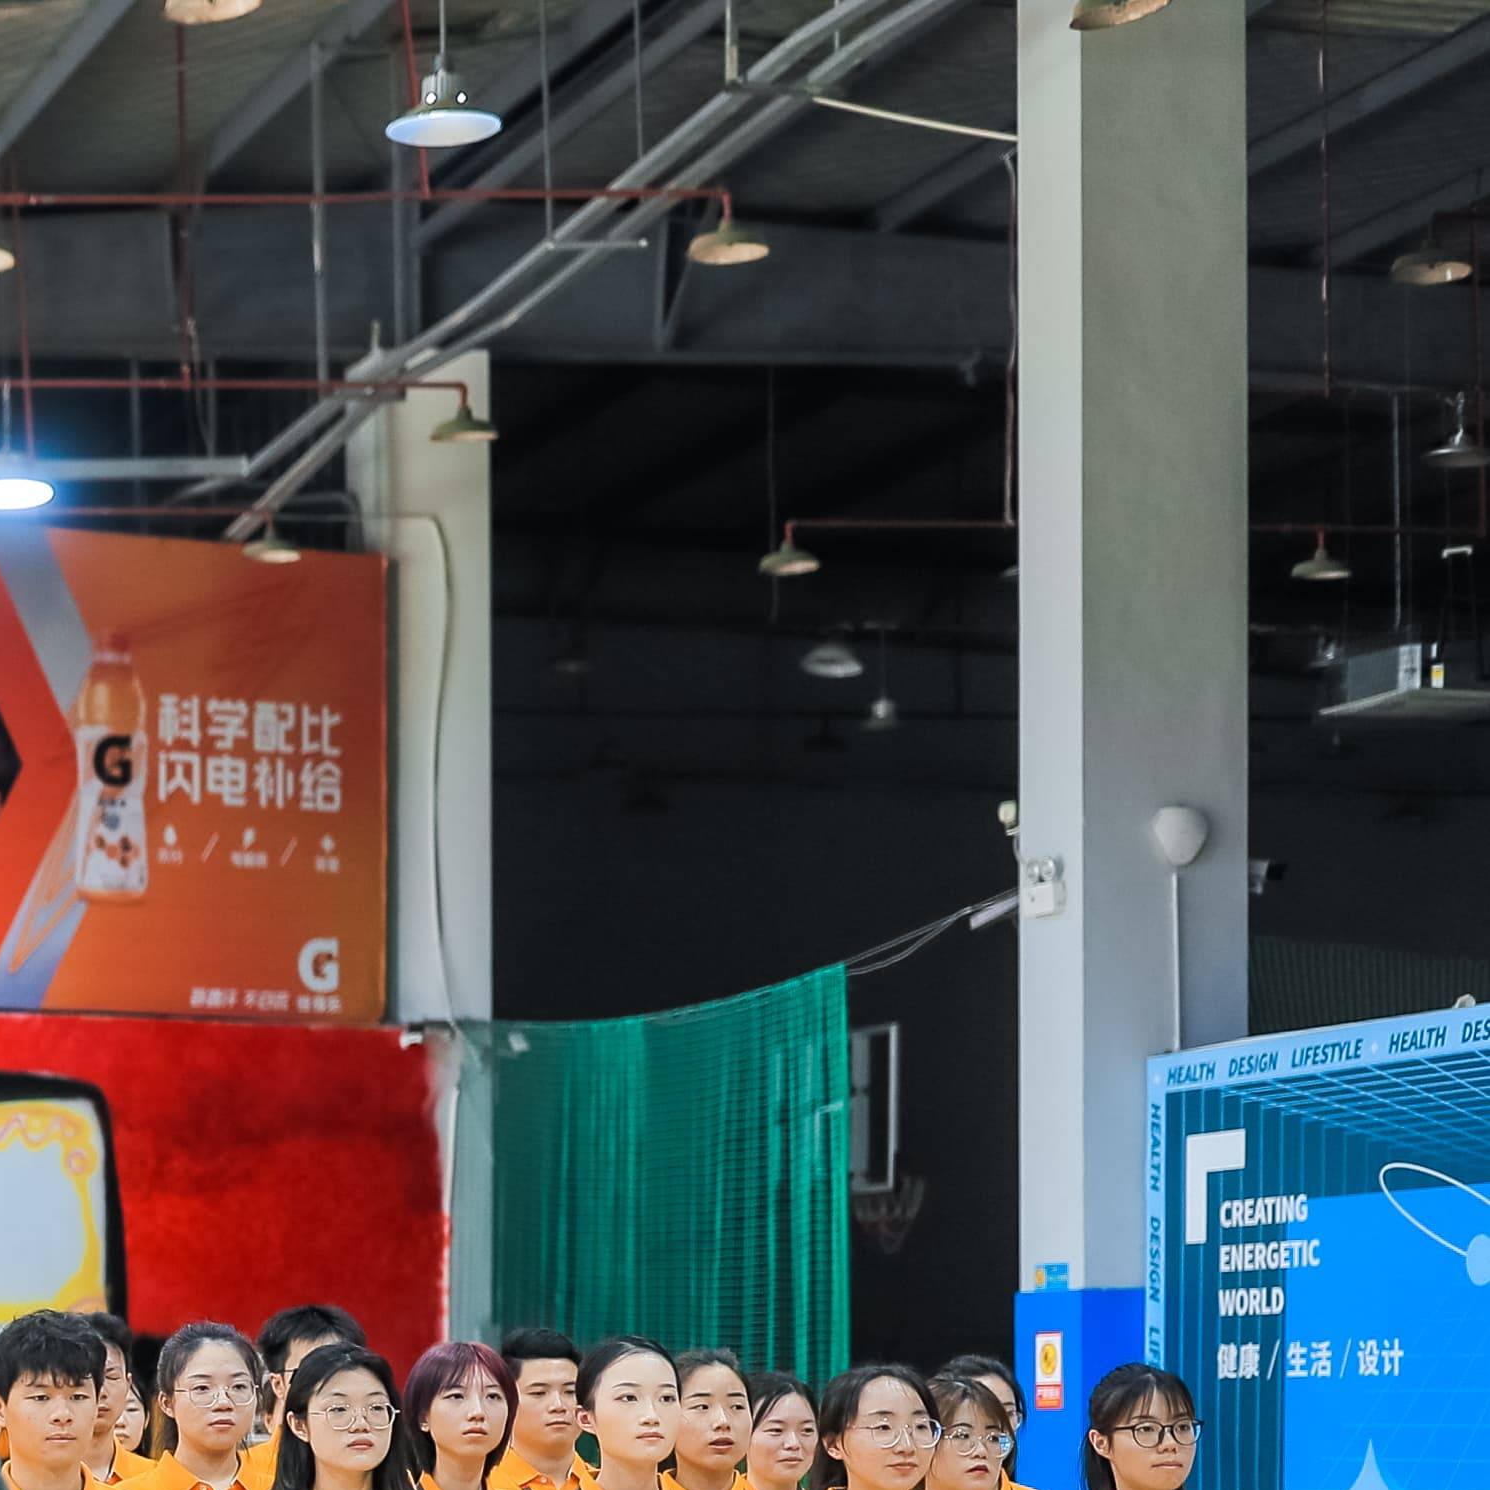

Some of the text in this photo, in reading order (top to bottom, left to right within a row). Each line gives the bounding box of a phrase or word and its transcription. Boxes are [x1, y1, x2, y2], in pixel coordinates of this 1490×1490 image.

[158, 693, 342, 757] 科学配比
[158, 750, 342, 813] 闪电补给
[1167, 1061, 1215, 1085] HEALTH
[1228, 1051, 1278, 1076] DESIGN
[1290, 1038, 1364, 1068] LIFESTYLE
[1388, 1025, 1447, 1055] HEALTH
[1150, 1103, 1162, 1193] HEALTH
[1220, 1194, 1308, 1229] CREATING
[1149, 1216, 1162, 1304] DESIGN
[1219, 1240, 1320, 1273] ENERGETIC
[1218, 1287, 1285, 1317] WORLD
[1217, 1341, 1261, 1380] 健康
[1286, 1341, 1333, 1378] 生活
[1357, 1338, 1404, 1377] 设计
